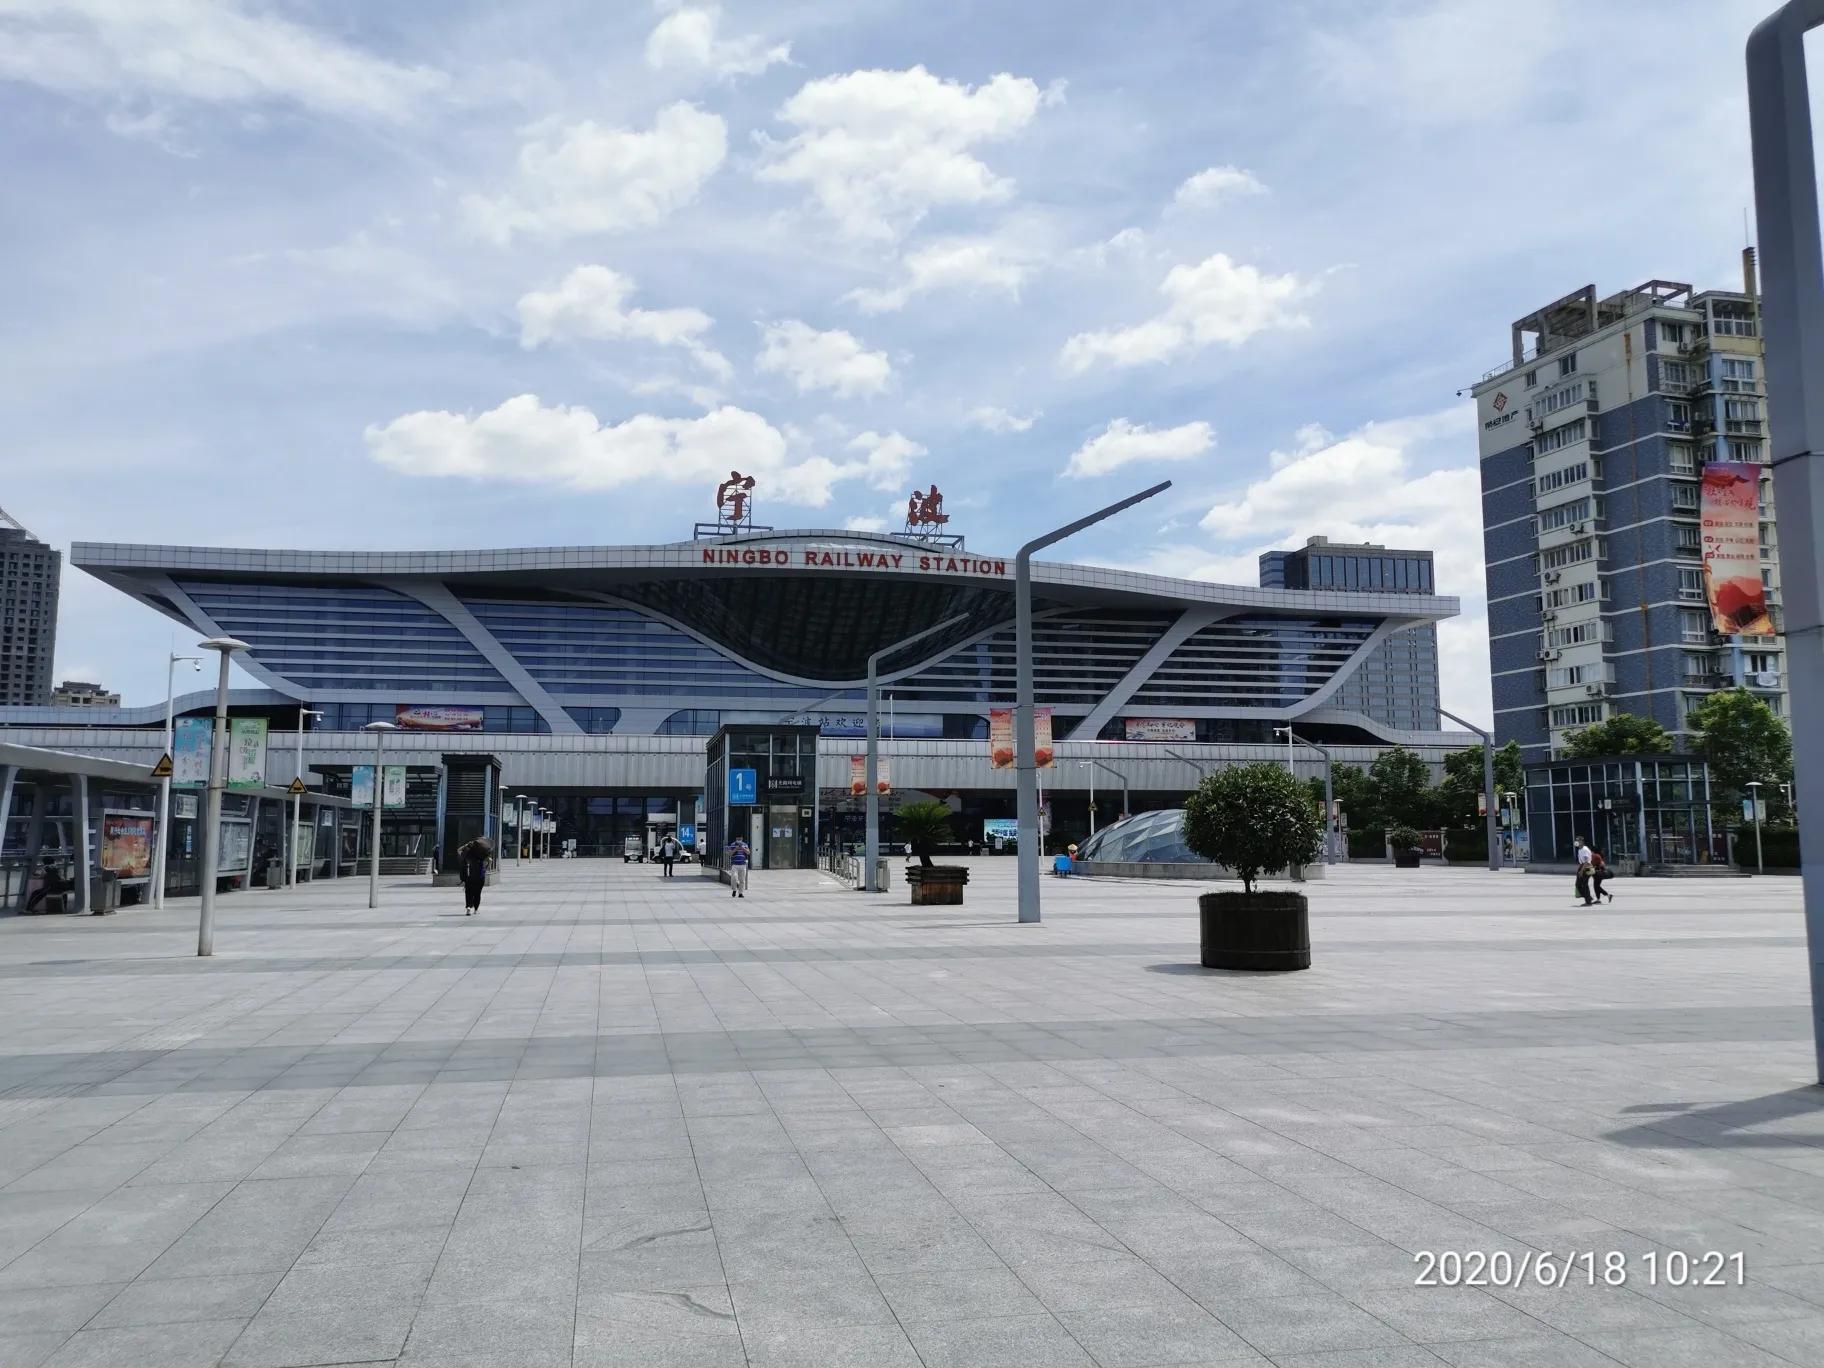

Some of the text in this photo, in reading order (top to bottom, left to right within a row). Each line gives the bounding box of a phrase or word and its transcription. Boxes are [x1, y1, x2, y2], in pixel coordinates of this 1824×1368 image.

[717, 471, 950, 526] 宁 波
[703, 548, 1005, 575] NINGBO RAILWAY STATION
